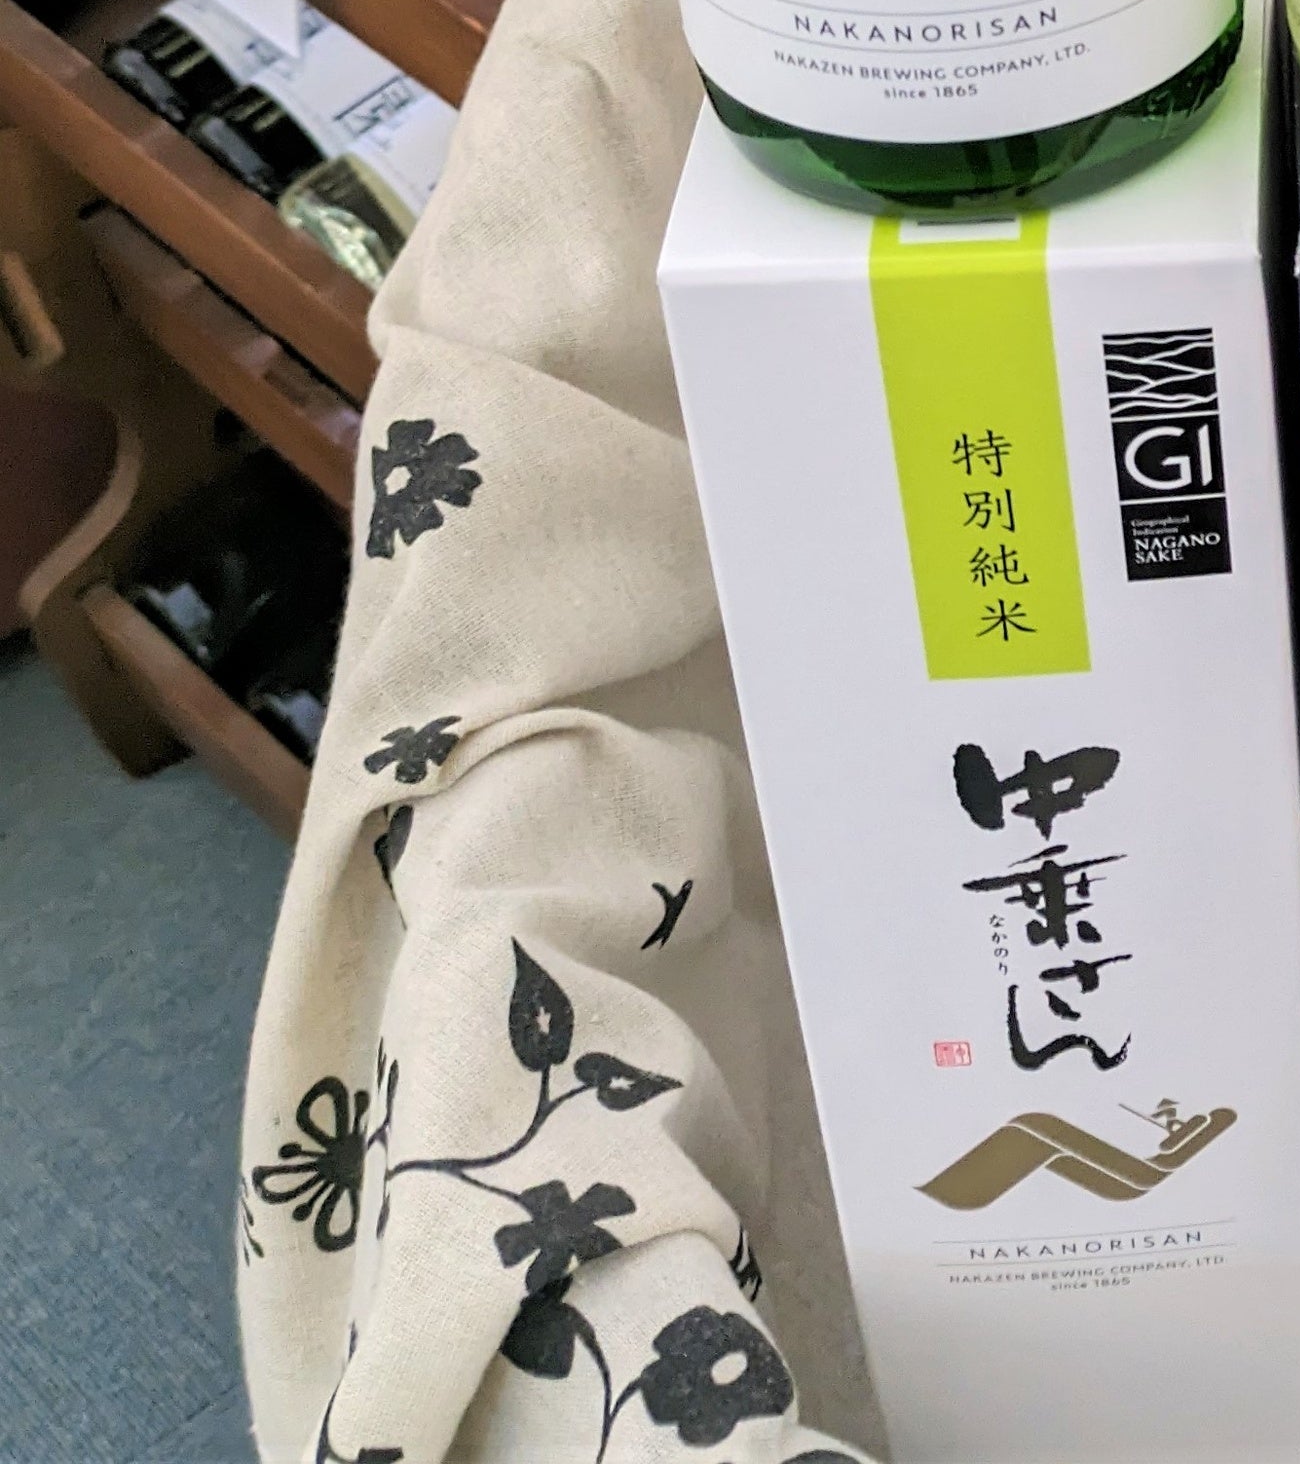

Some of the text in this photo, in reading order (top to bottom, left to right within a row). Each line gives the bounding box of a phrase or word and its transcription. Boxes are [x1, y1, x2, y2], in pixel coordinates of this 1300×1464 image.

[794, 6, 1057, 43] NAKANORISAN
[774, 42, 1091, 81] NAKAZEN BREWING COMPANY, LTD.
[884, 84, 978, 99] since 1865
[1124, 424, 1213, 491] GI
[951, 429, 1037, 641] 特別純米
[1134, 532, 1221, 551] NAGANO
[1135, 548, 1184, 565] SAKE
[989, 914, 1009, 976] なかのり
[969, 1230, 1202, 1261] NAKANORISAN
[949, 1272, 1026, 1285] NAKAZEN
[1030, 1269, 1104, 1282] BREWING
[1050, 1276, 1131, 1291] since 1865
